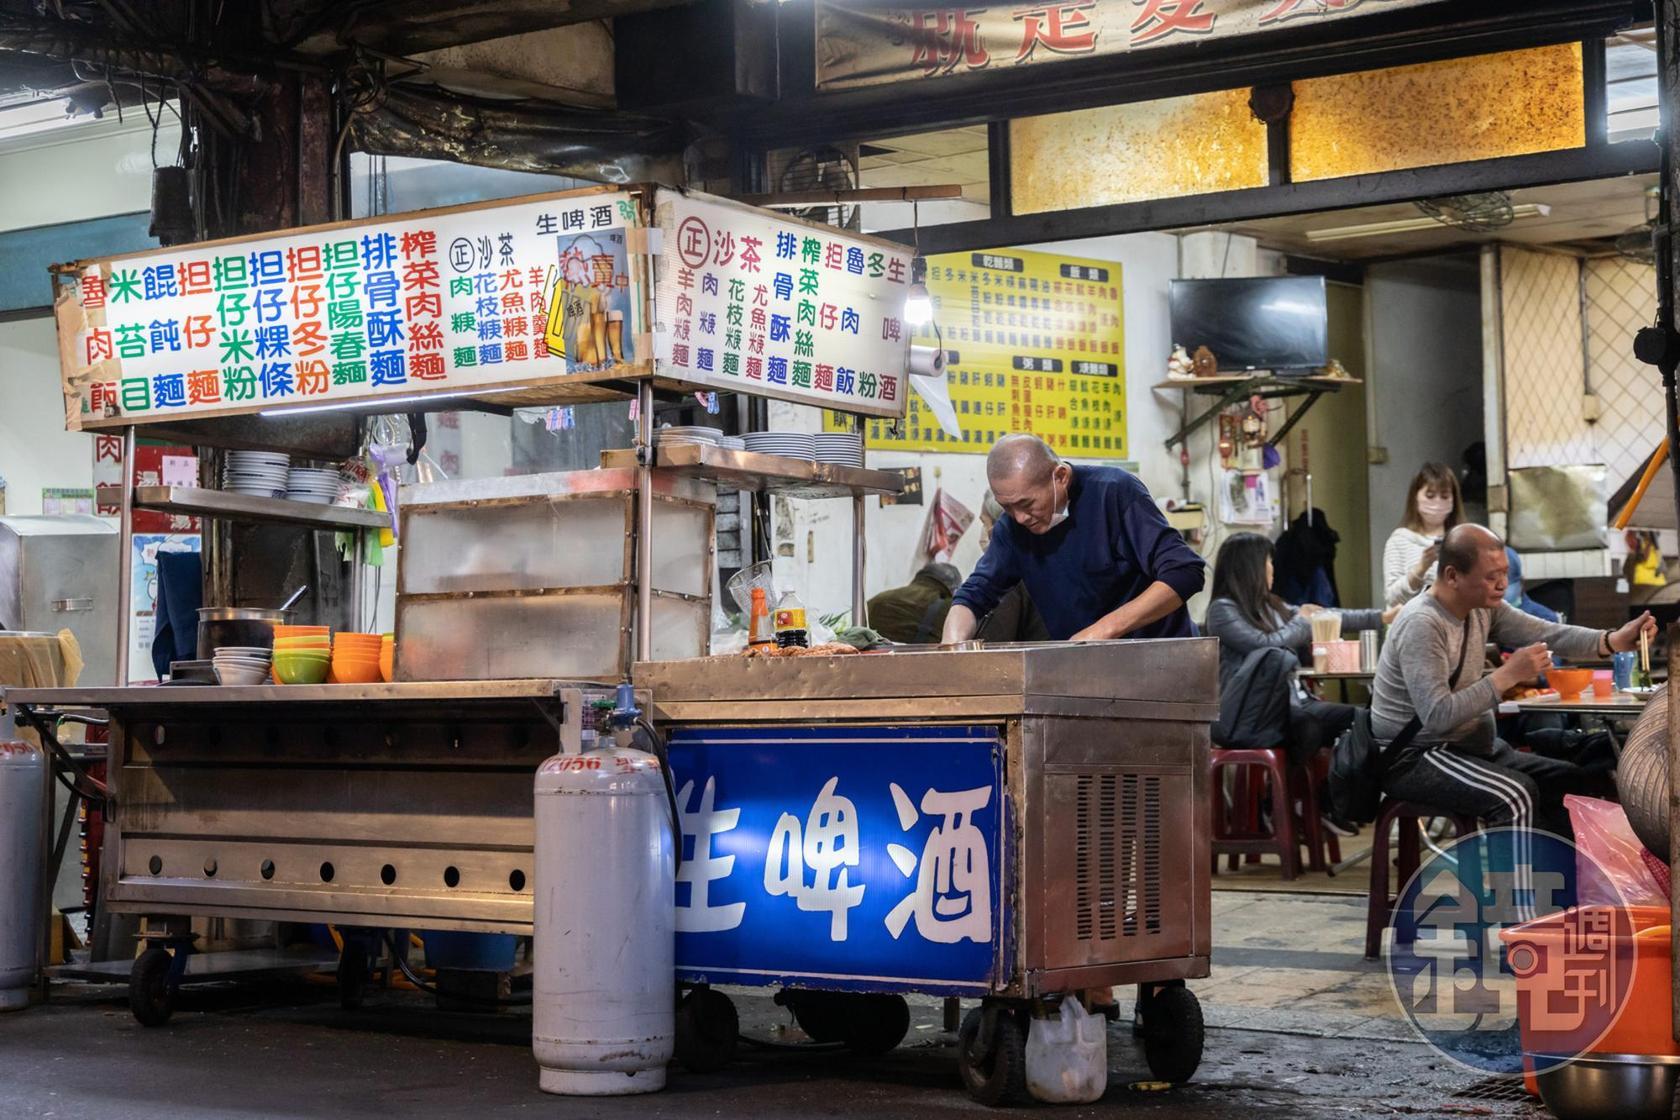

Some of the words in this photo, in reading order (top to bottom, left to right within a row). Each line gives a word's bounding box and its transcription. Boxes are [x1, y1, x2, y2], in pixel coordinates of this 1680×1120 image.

[536, 204, 613, 236] 生啤酒
[109, 268, 151, 412] 米苔目
[142, 264, 187, 409] 餛飩麵
[177, 260, 222, 406] 担仔麵
[212, 255, 258, 401] 担仔米粉
[248, 250, 295, 399] 担仔粿條
[285, 246, 331, 396] 担仔冬粉
[322, 240, 368, 386] 担仔陽春麵
[360, 232, 408, 388] 排骨酥麵
[400, 230, 447, 381] 榨菜肉絲麵
[767, 229, 797, 386] 排骨酥麵
[791, 235, 822, 389] 榨菜肉絲麵
[814, 240, 843, 393] 担仔麵
[836, 246, 865, 396] 魯肉飯
[857, 252, 886, 400] 冬粉
[877, 257, 906, 402] 生啤酒
[675, 774, 993, 944] 生啤酒
